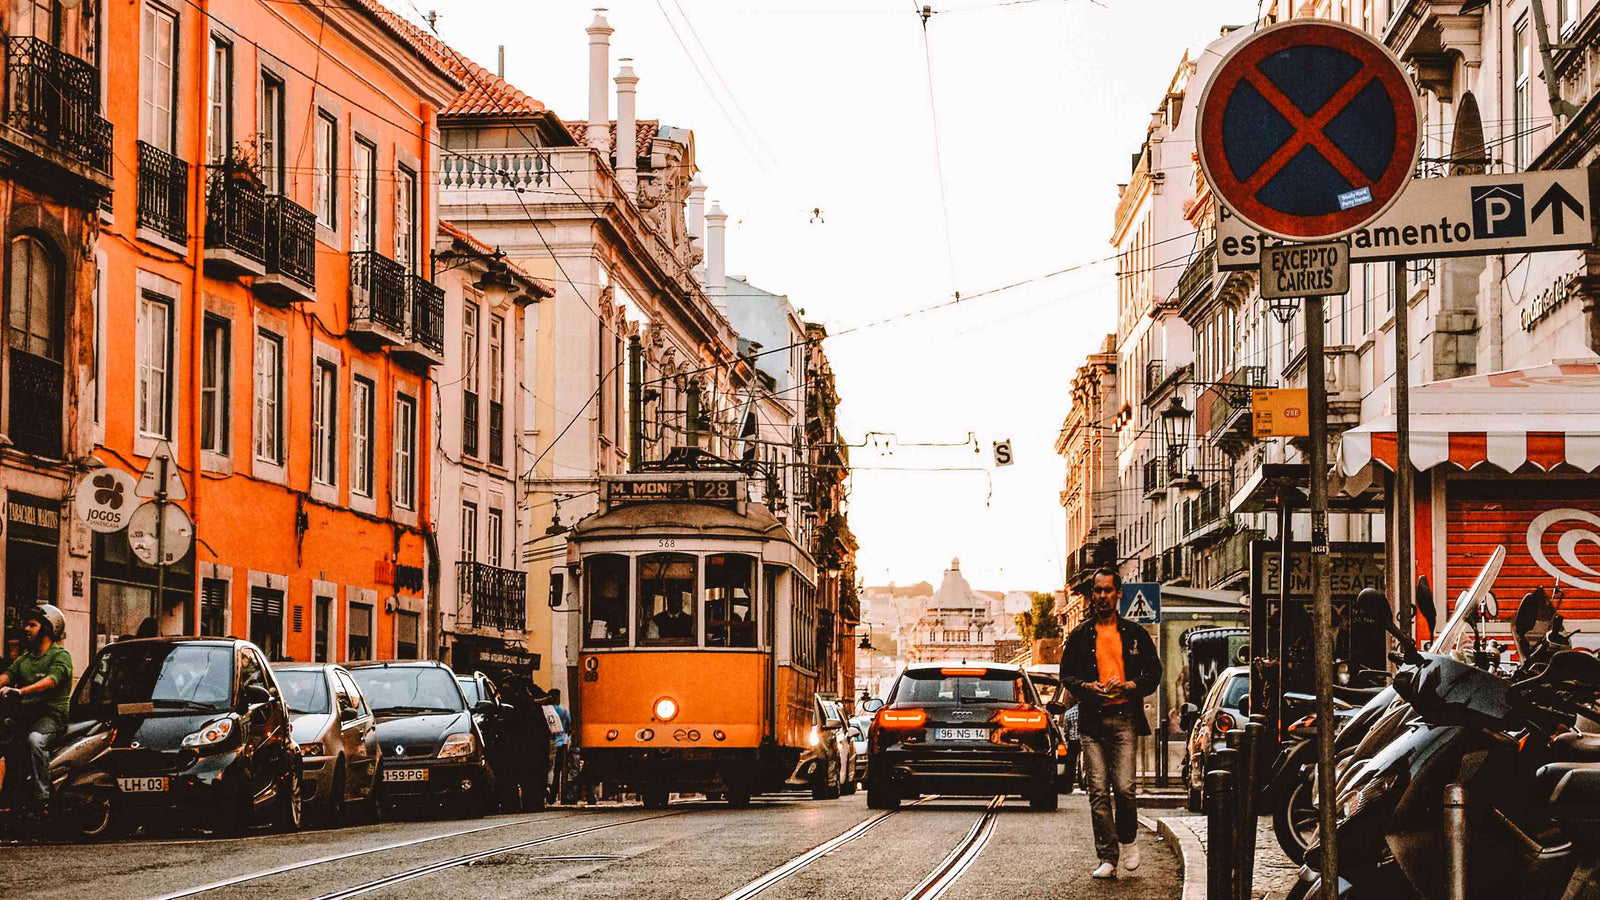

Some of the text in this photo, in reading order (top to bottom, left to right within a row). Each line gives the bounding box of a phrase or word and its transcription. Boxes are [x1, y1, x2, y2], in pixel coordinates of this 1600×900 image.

[1485, 198, 1511, 234] P
[1271, 247, 1338, 272] EXCEPTO
[1277, 268, 1333, 292] CARRIS
[996, 444, 1010, 464] S
[633, 482, 684, 494] MONIZ
[704, 482, 729, 497] 28
[86, 508, 121, 523] JOGOS
[659, 540, 675, 548] 568
